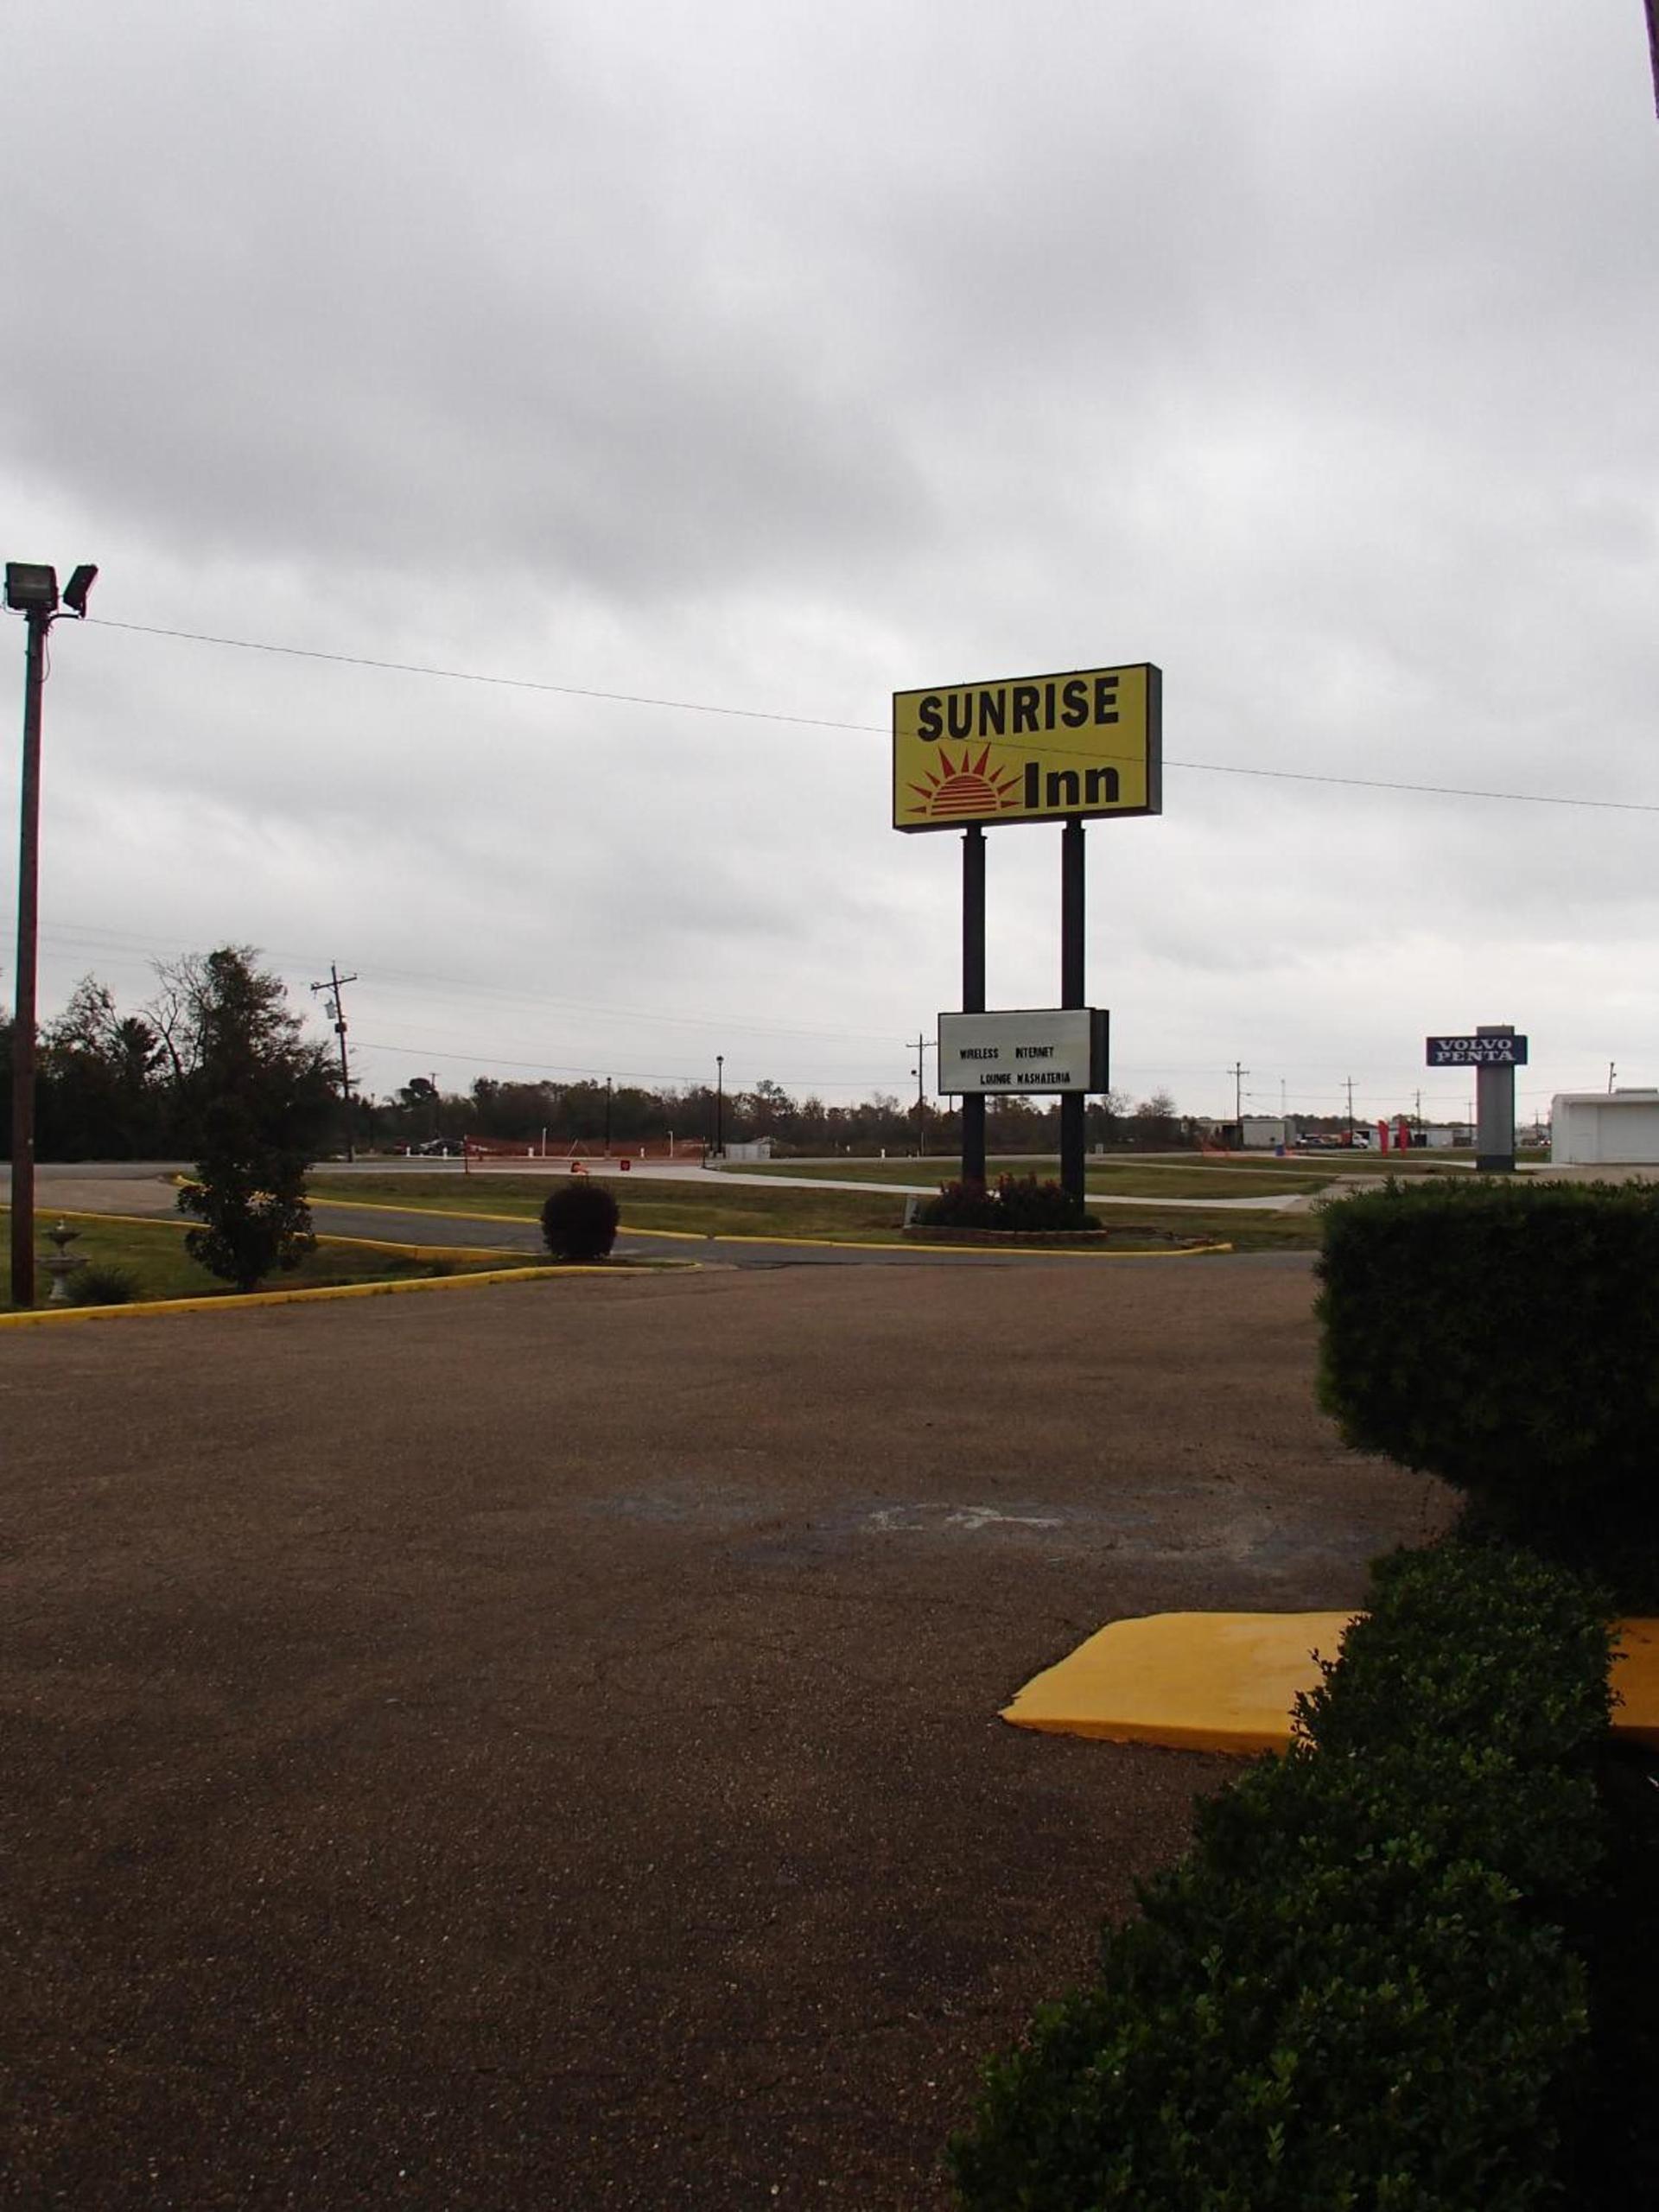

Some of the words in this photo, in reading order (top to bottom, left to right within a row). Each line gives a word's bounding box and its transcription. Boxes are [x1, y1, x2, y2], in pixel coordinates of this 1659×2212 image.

[918, 677, 1119, 742] SUNRISE
[1024, 761, 1119, 810] Inn
[1437, 1039, 1512, 1051] VOLVO
[959, 1047, 999, 1060] WIRELESS
[1015, 1046, 1054, 1058] INTERNET
[1436, 1050, 1516, 1062] PENTA
[980, 1073, 1012, 1085] LOUNGE
[1017, 1071, 1071, 1084] WASHATERIA
